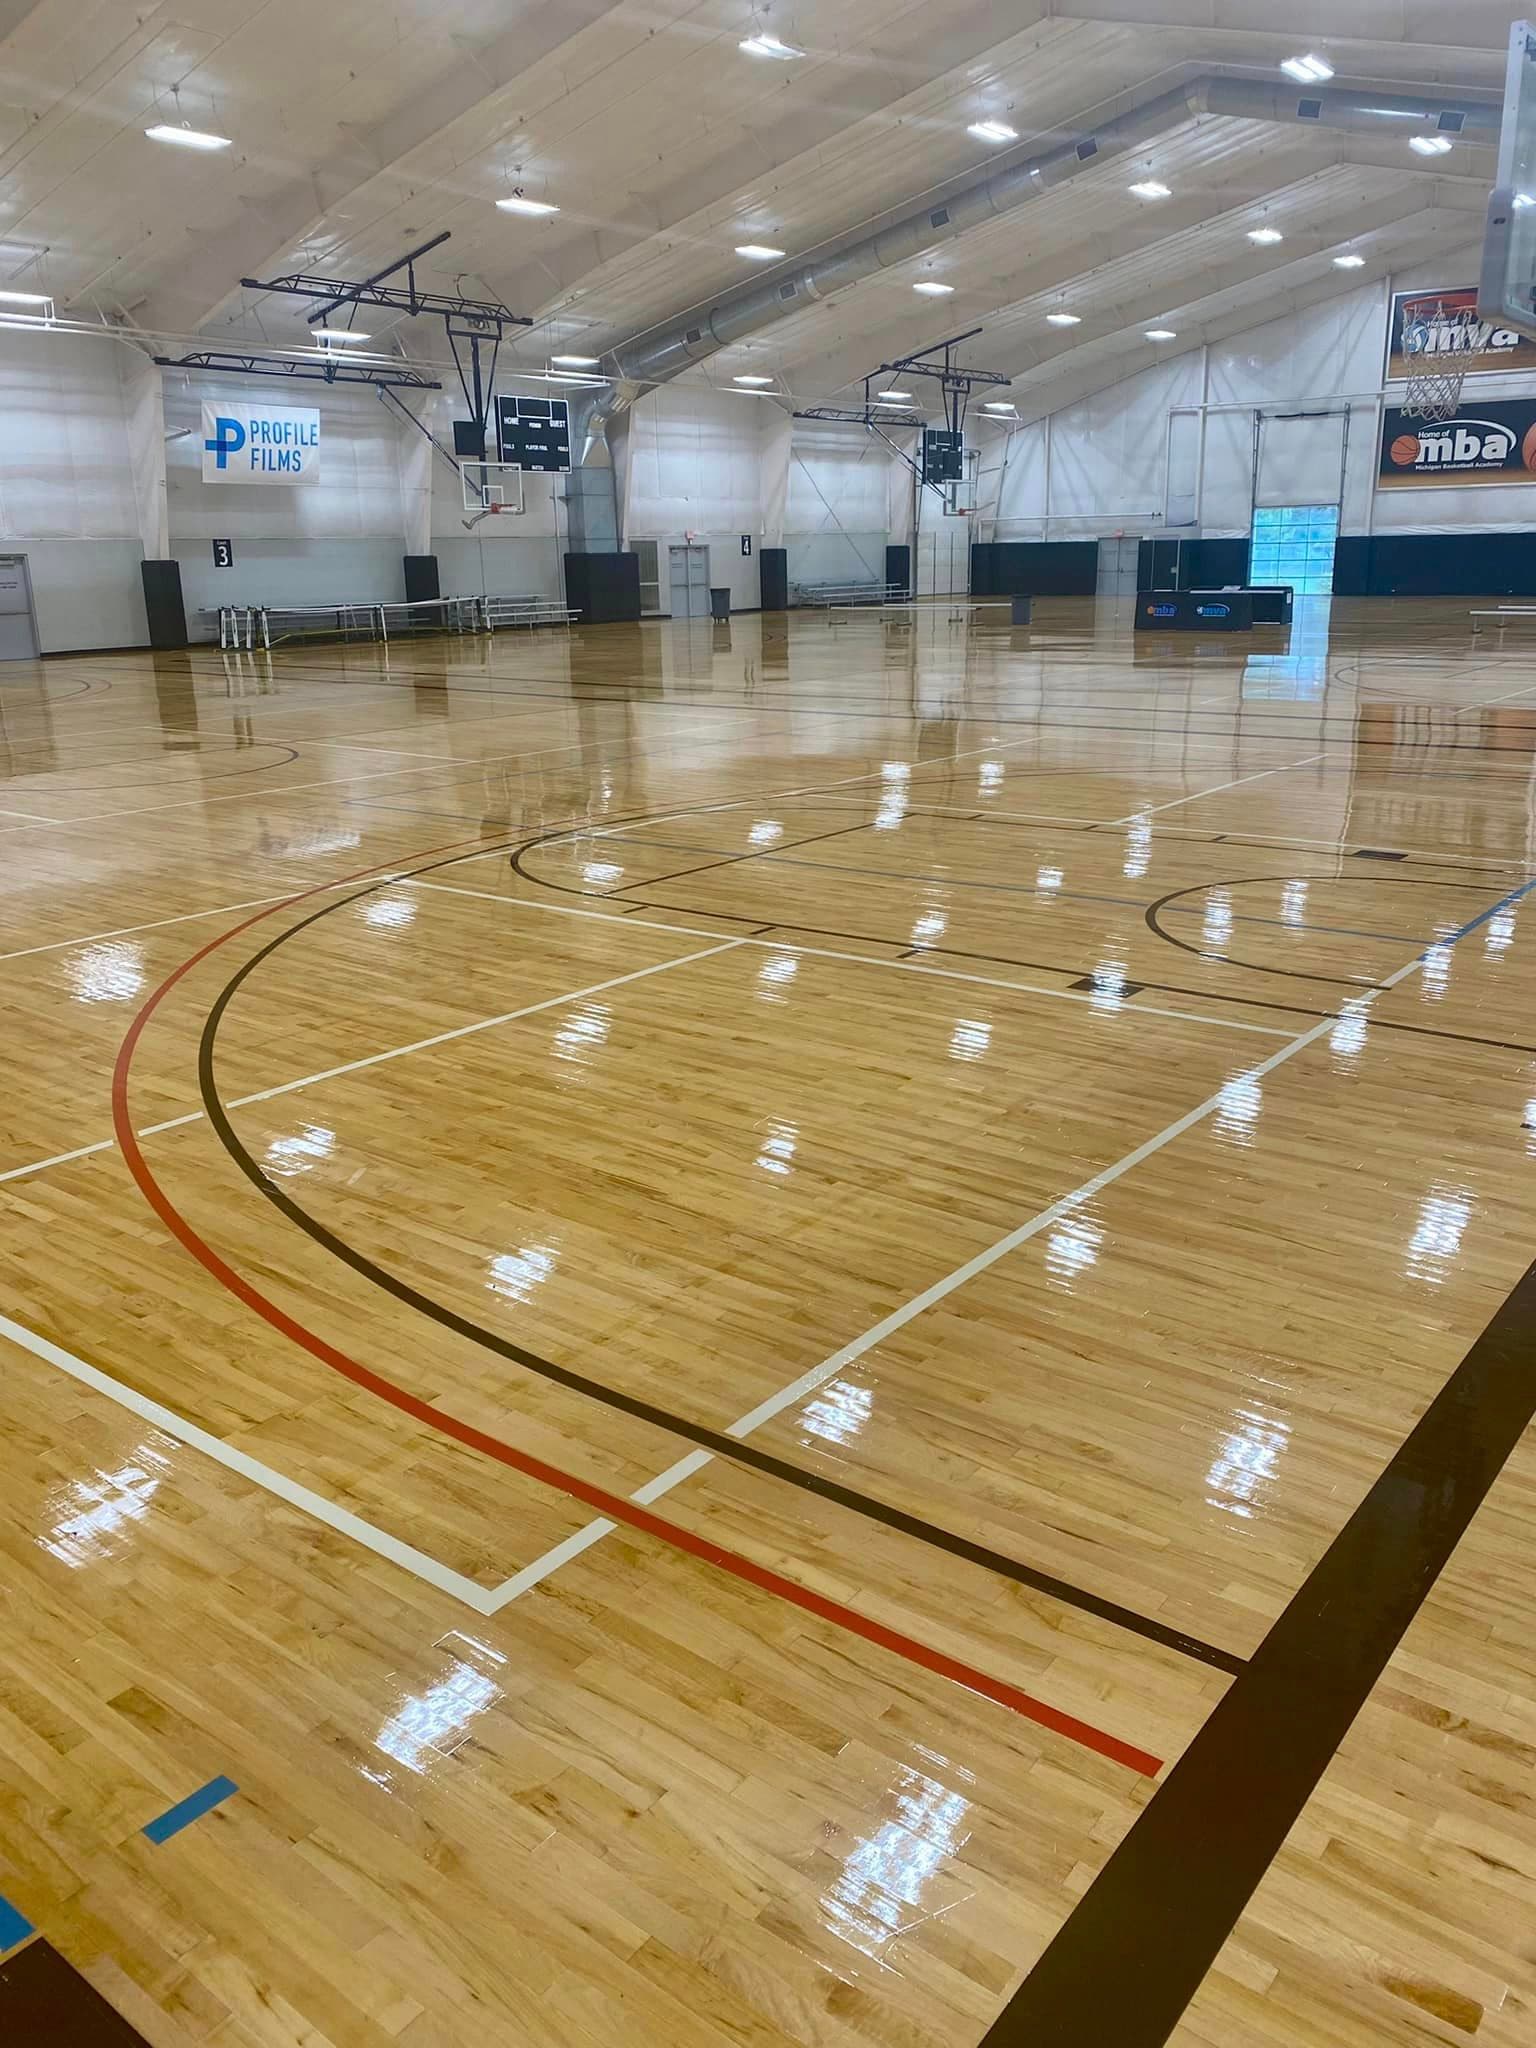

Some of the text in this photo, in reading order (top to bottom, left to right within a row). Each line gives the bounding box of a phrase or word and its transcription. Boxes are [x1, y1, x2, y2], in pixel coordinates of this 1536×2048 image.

[249, 420, 319, 446] PROFILE
[1418, 429, 1450, 439] Home of
[1415, 428, 1508, 463] mba
[250, 447, 302, 472] FILMS
[1443, 462, 1474, 470] Basketball
[218, 546, 229, 566] 3
[743, 540, 750, 555] 4
